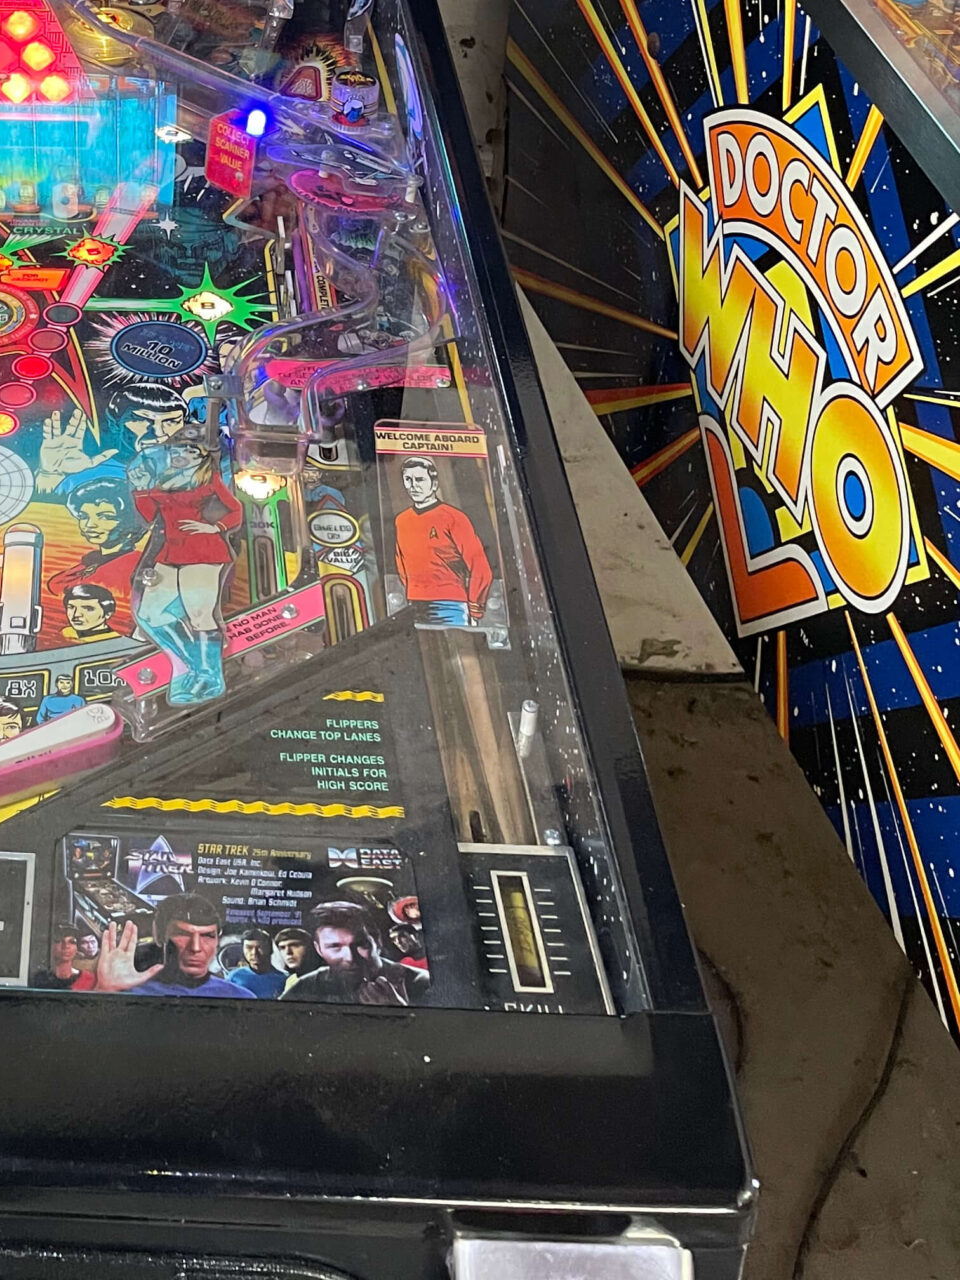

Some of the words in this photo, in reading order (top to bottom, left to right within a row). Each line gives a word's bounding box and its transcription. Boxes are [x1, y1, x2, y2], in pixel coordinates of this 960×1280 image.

[216, 122, 250, 145] COLLECT
[215, 138, 250, 160] SCANNER
[219, 153, 243, 172] VALUE
[12, 226, 81, 235] CRYSTAL
[717, 132, 898, 393] DOCTOR
[147, 340, 175, 356] 10
[122, 342, 182, 370] MILLION
[678, 178, 910, 614] WHO
[375, 432, 431, 442] WELCOME
[434, 434, 480, 444] ABOARD
[402, 441, 454, 452] CAPTAIN!
[333, 549, 350, 557] BIG
[232, 619, 250, 628] NO
[250, 607, 277, 622] MAN
[228, 626, 253, 640] HAS
[253, 614, 283, 630] GONE
[5, 678, 37, 698] 8X
[326, 719, 379, 730] FLIPPERS
[270, 729, 317, 740] CHANGE
[318, 731, 341, 741] TOP
[343, 732, 381, 743] LANES
[279, 752, 326, 764] FLIPPER
[329, 754, 385, 765] CHANGES
[311, 766, 360, 777] INITIALS
[363, 767, 387, 778] FOR
[316, 779, 346, 790] HIGH
[349, 780, 389, 791] SCORE
[124, 849, 177, 862] STAR
[197, 842, 224, 855] STAR
[225, 844, 249, 856] TREK
[270, 849, 312, 861] Anniversary
[359, 847, 402, 859] DATA
[197, 856, 214, 865] Data
[215, 857, 231, 866] East
[359, 858, 403, 870] EAST
[224, 868, 238, 876] Joe
[278, 870, 287, 878] Ed
[230, 878, 250, 886] Kevin
[250, 888, 285, 899] Margaret
[268, 898, 298, 908] Schmidt
